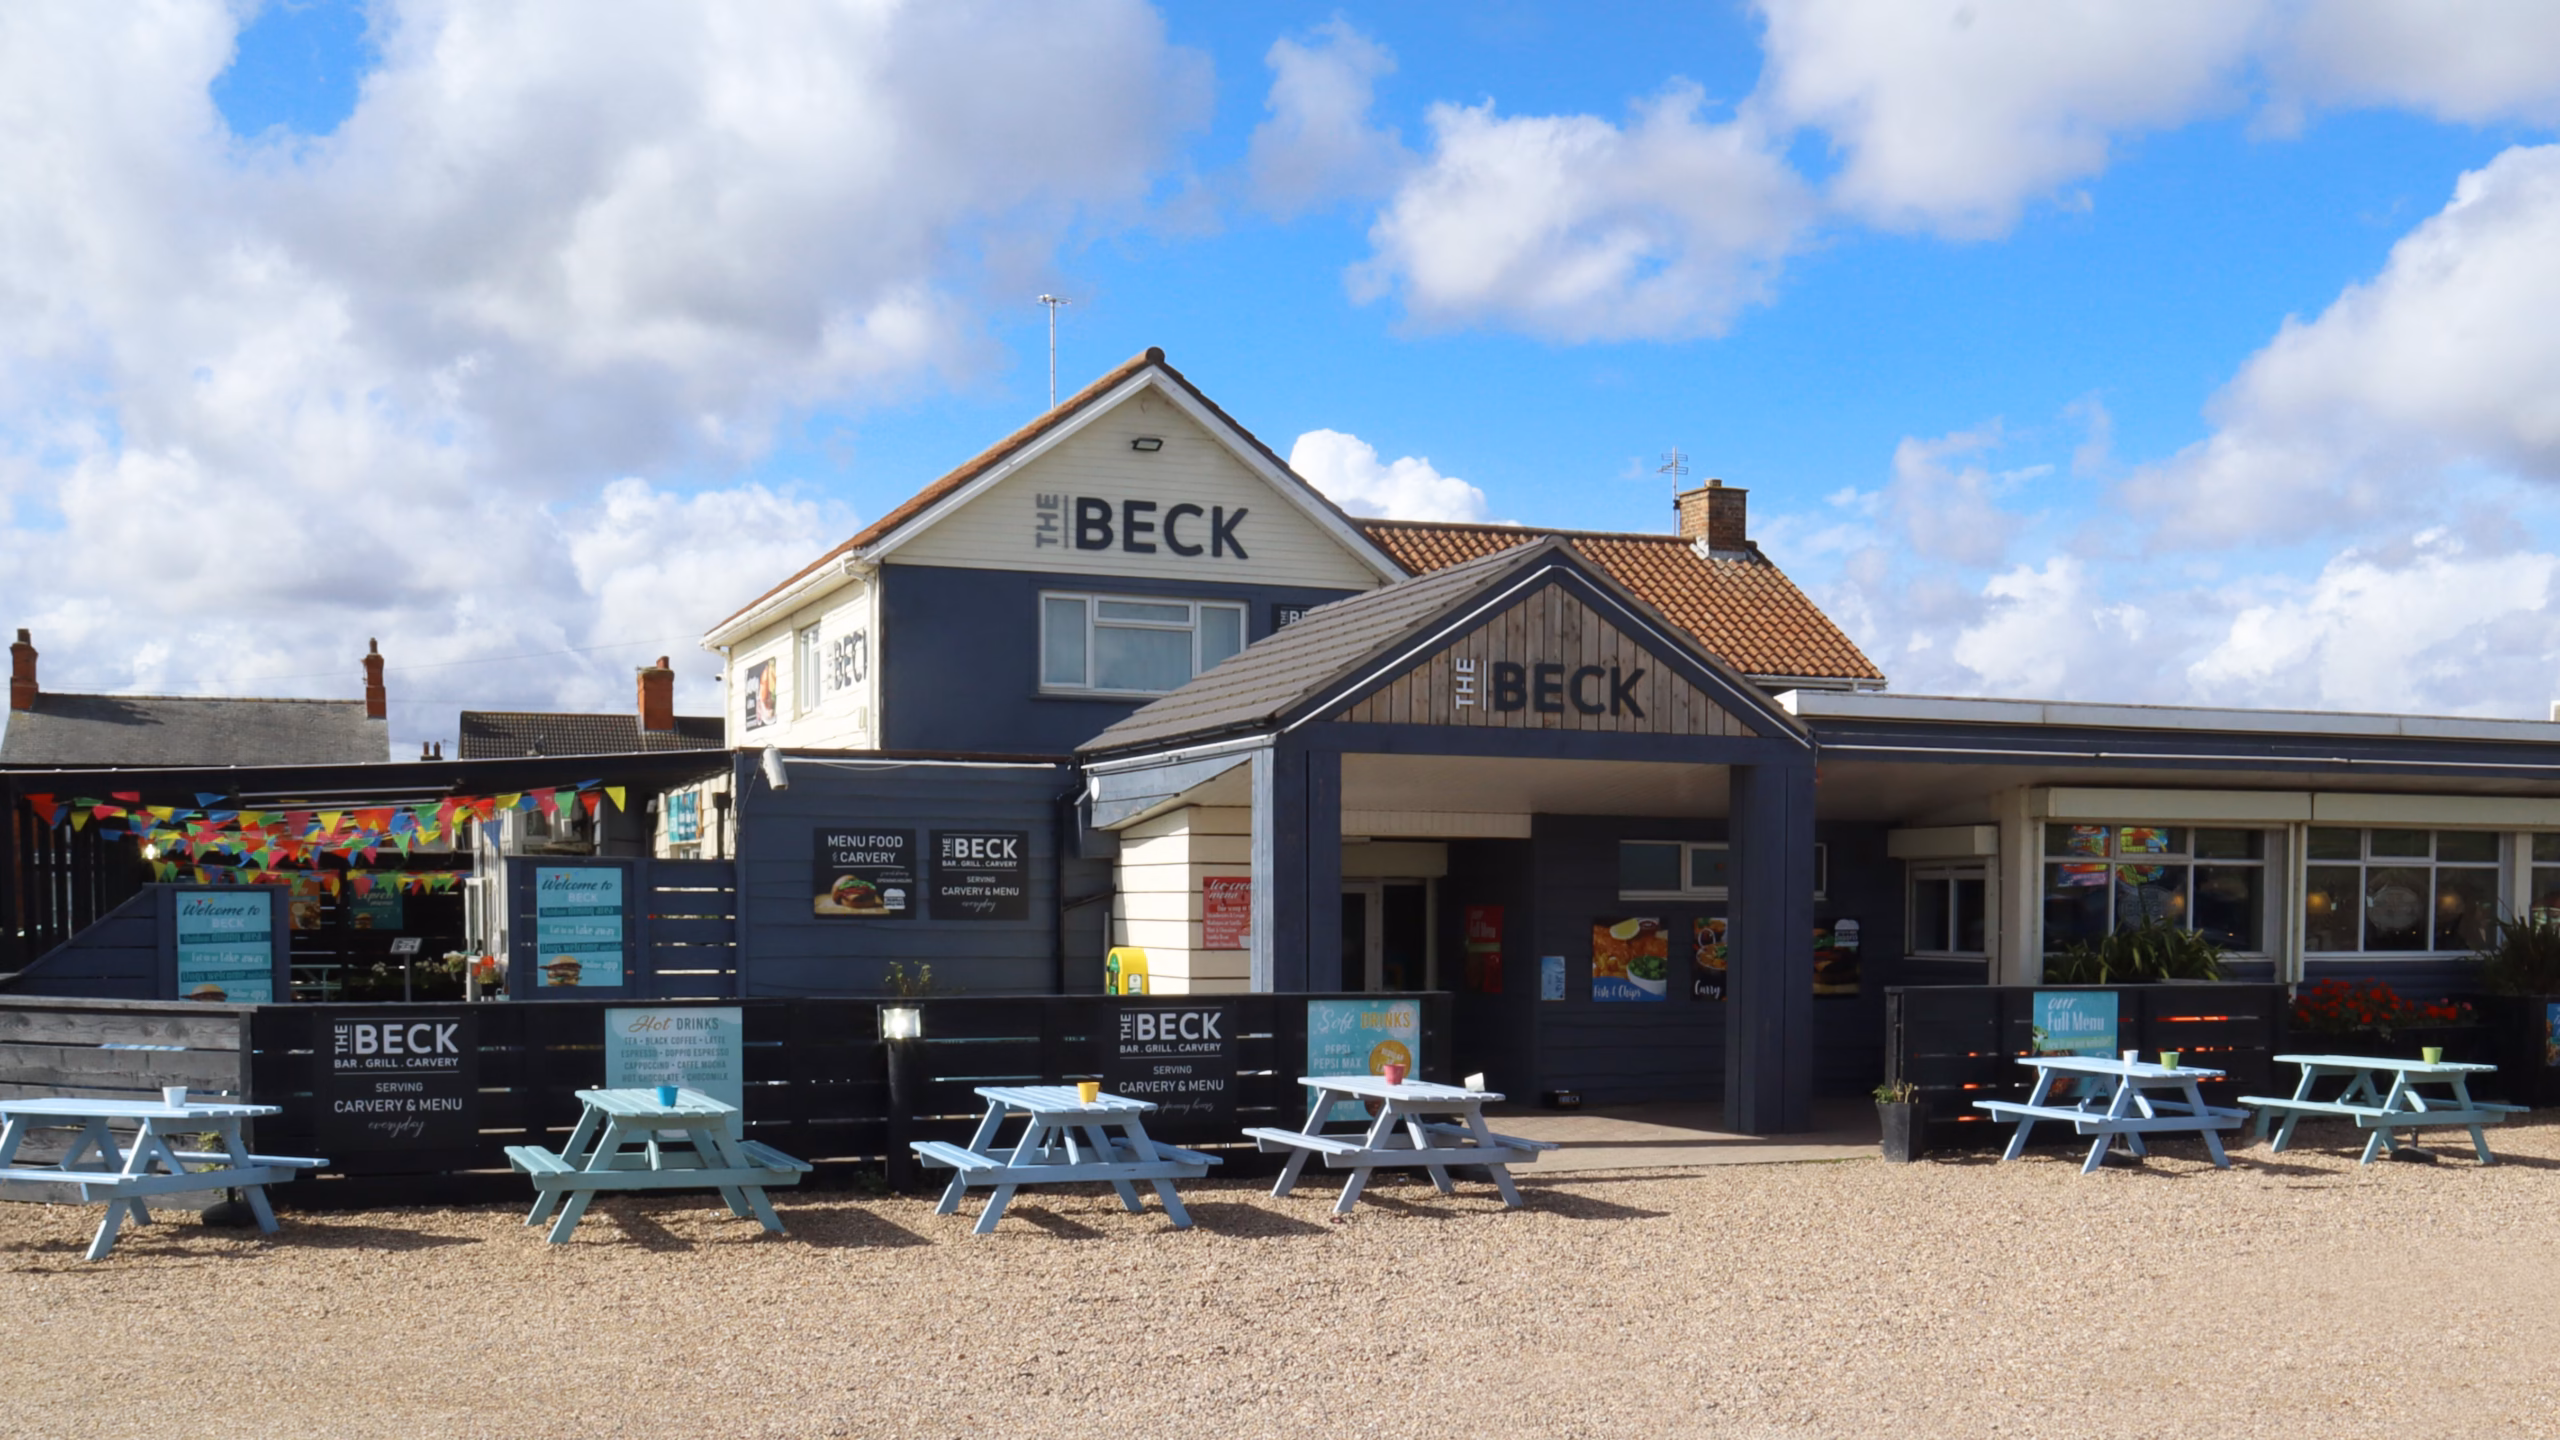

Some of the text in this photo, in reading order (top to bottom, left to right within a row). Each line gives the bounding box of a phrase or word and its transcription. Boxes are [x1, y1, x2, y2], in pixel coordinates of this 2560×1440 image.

[1036, 493, 1058, 548] THE
[1076, 497, 1249, 560] BECK
[1455, 657, 1475, 710] THE
[1493, 662, 1646, 718] BECK
[828, 835, 903, 848] MENU FOOD
[942, 838, 951, 858] THE
[955, 838, 1018, 859] BECK
[840, 851, 896, 863] CARVERY
[942, 860, 1017, 868] BAR GRILL CARVERY
[542, 878, 614, 891] Welcome to
[966, 875, 996, 884] SERVING
[568, 892, 599, 903] BECK
[941, 886, 1020, 897] CARVERY & MENU
[183, 902, 260, 916] Welcome to
[211, 917, 245, 928] BECK
[1593, 984, 1609, 998] Fish
[1618, 984, 1642, 1000] Chips
[1694, 979, 1722, 999] Curry
[2047, 997, 2078, 1011] our
[627, 1015, 720, 1033] Hot DRINKS
[1120, 1013, 1132, 1041] THE
[1137, 1012, 1222, 1041] BECK
[1318, 1008, 1411, 1035] Soft DRINKS
[2047, 1010, 2105, 1032] Full Menu
[334, 1024, 348, 1055] THE
[355, 1023, 460, 1055] BECK
[624, 1035, 726, 1046] TEA BLACK COFFEE LATTE
[621, 1047, 730, 1058] ESPRESSO DOPPIO ESPRESSO
[1120, 1042, 1222, 1054] BAR GRILL CARVERY
[1324, 1043, 1351, 1055] PEPSI
[334, 1057, 459, 1069] BAR GRILL CARVERY
[624, 1061, 670, 1070] CAPPUCCINO
[700, 1059, 727, 1069] MOCHA
[1153, 1065, 1193, 1075] SERVING
[1313, 1057, 1339, 1069] PEPSI
[1342, 1057, 1362, 1069] MAX
[638, 1072, 680, 1083] CHOCOLATE
[375, 1082, 424, 1093] SERVING
[1119, 1079, 1225, 1094] CARVERY & MENU
[334, 1098, 463, 1113] CARVERY & MENU
[368, 1115, 425, 1138] everyday
